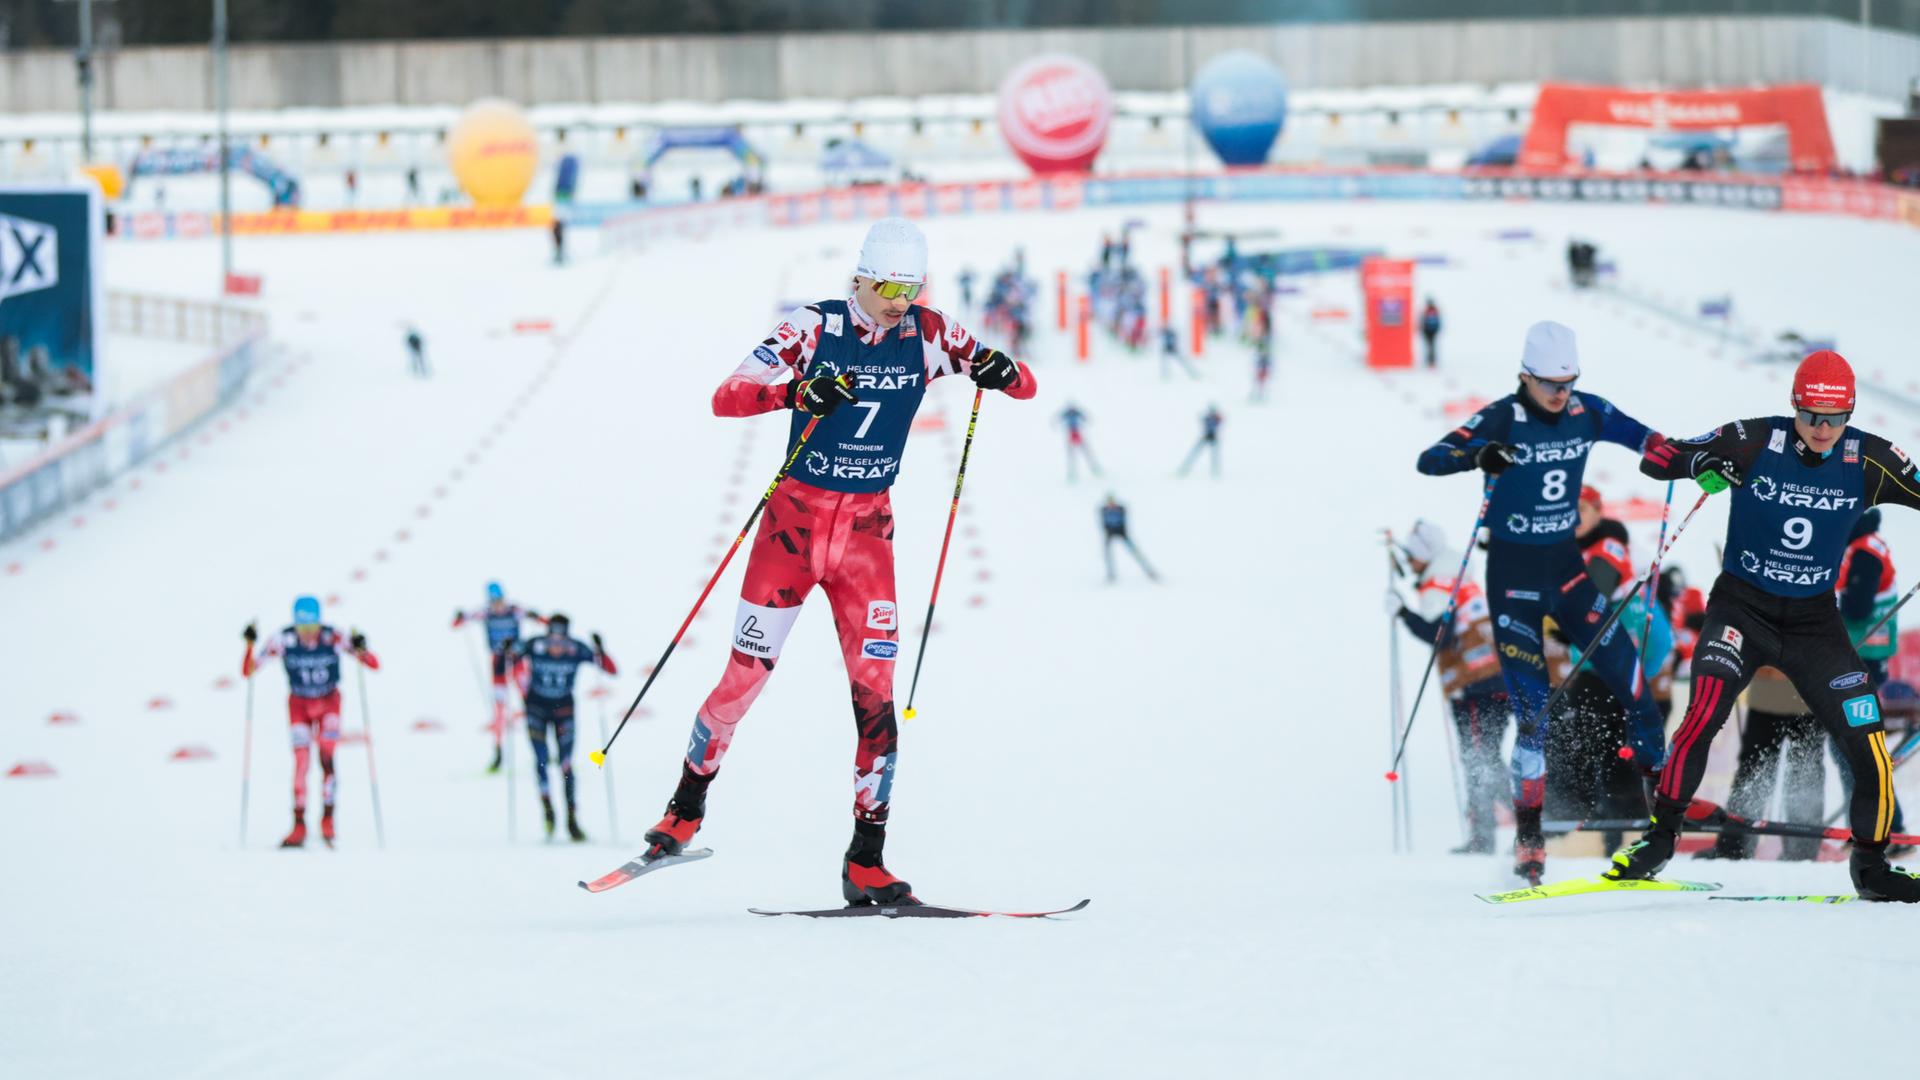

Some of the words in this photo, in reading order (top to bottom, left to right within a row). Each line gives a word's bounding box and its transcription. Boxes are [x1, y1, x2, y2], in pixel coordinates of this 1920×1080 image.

[846, 365, 906, 374] HELGELAND
[855, 373, 920, 390] RAFT
[852, 401, 882, 439] 7
[838, 442, 884, 452] TRONDHEIM
[1535, 437, 1582, 450] HELGELAND
[1535, 440, 1592, 463] KRAFT
[832, 461, 898, 479] KRAFT
[834, 456, 893, 466] HELGELAND
[1541, 468, 1568, 501] 8
[1782, 481, 1844, 497] HELGELAND
[1778, 491, 1858, 511] KRAFT
[1780, 517, 1814, 550] 9
[1769, 549, 1814, 561] TRONDHEIM
[1764, 559, 1823, 573] HELGELAND
[1763, 567, 1832, 586] KRAFT
[735, 634, 772, 653] Löffler
[1849, 699, 1875, 720] TQ
